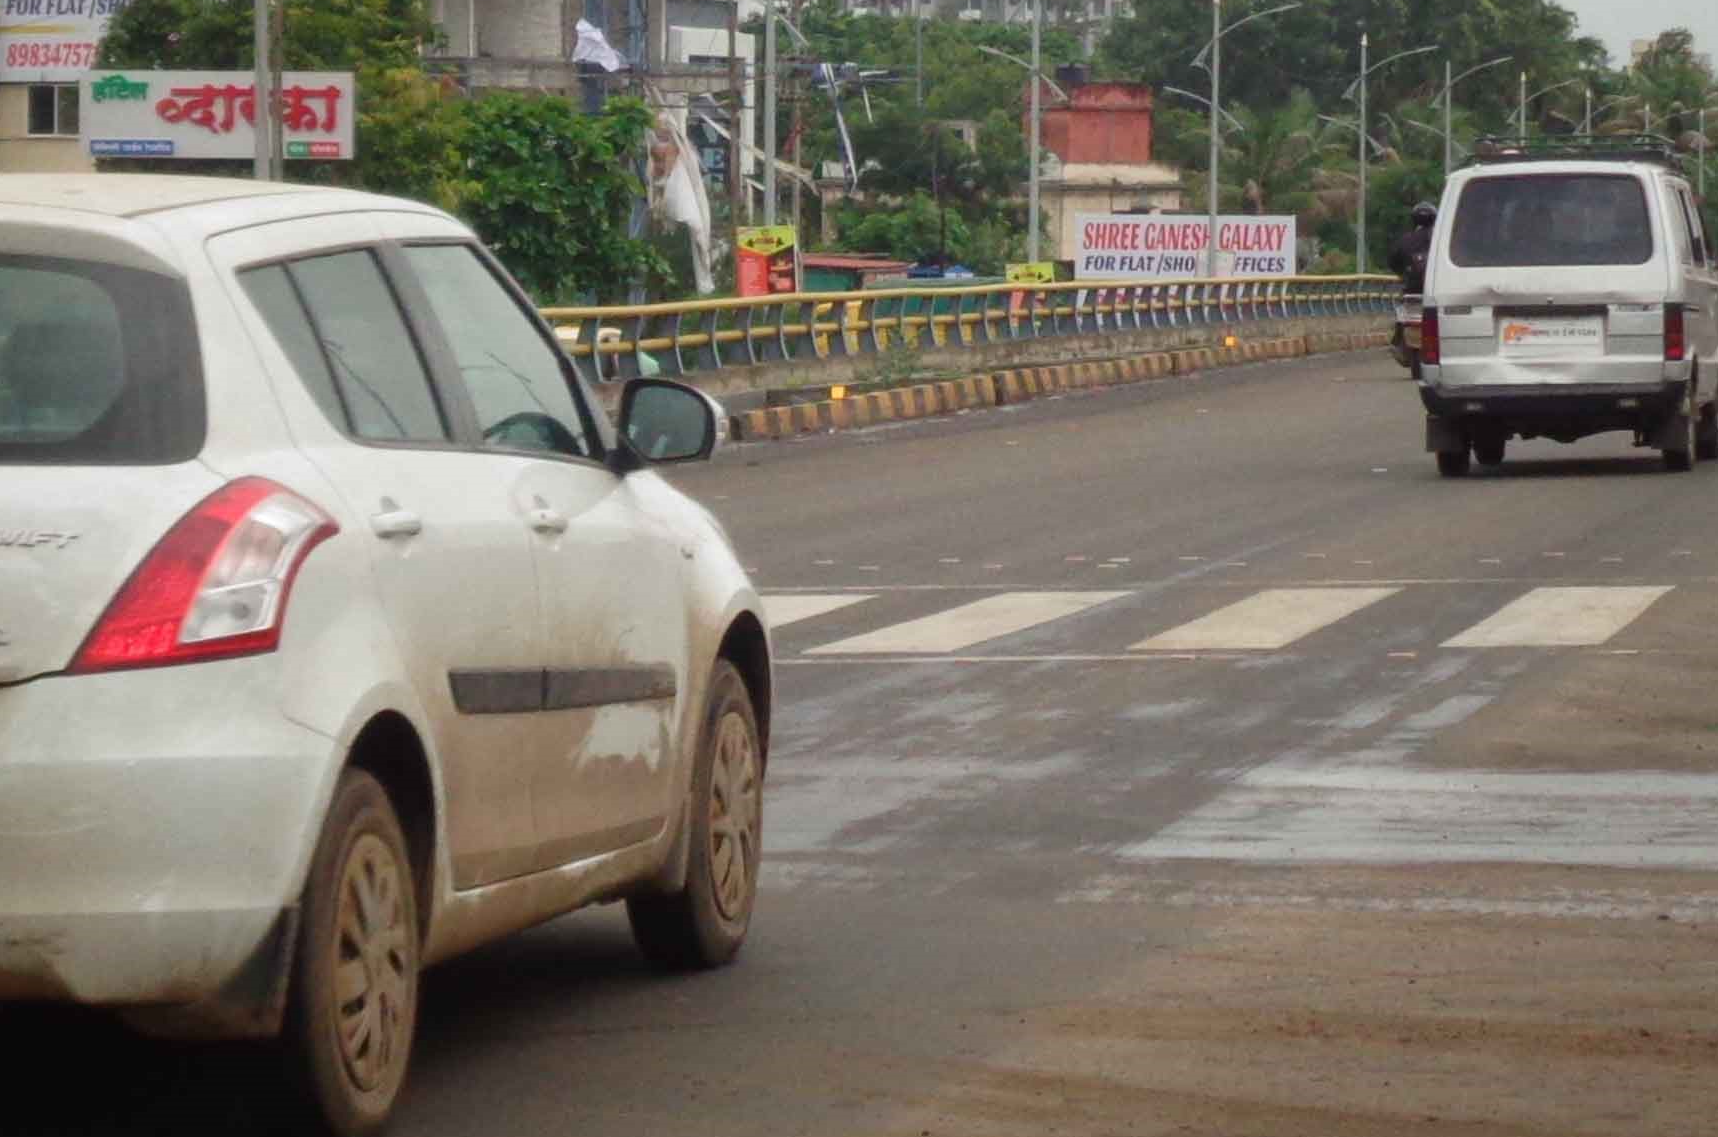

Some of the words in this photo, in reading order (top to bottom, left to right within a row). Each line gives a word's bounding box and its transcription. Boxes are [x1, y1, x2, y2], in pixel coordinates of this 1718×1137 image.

[1083, 222, 1140, 251] SHREE
[1145, 222, 1212, 251] GANESH
[1219, 222, 1288, 251] GALAXY
[1084, 254, 1117, 271] FOR
[1119, 254, 1155, 272] FLAT
[1156, 254, 1195, 275] /SHO
[1234, 255, 1285, 272] FFICES
